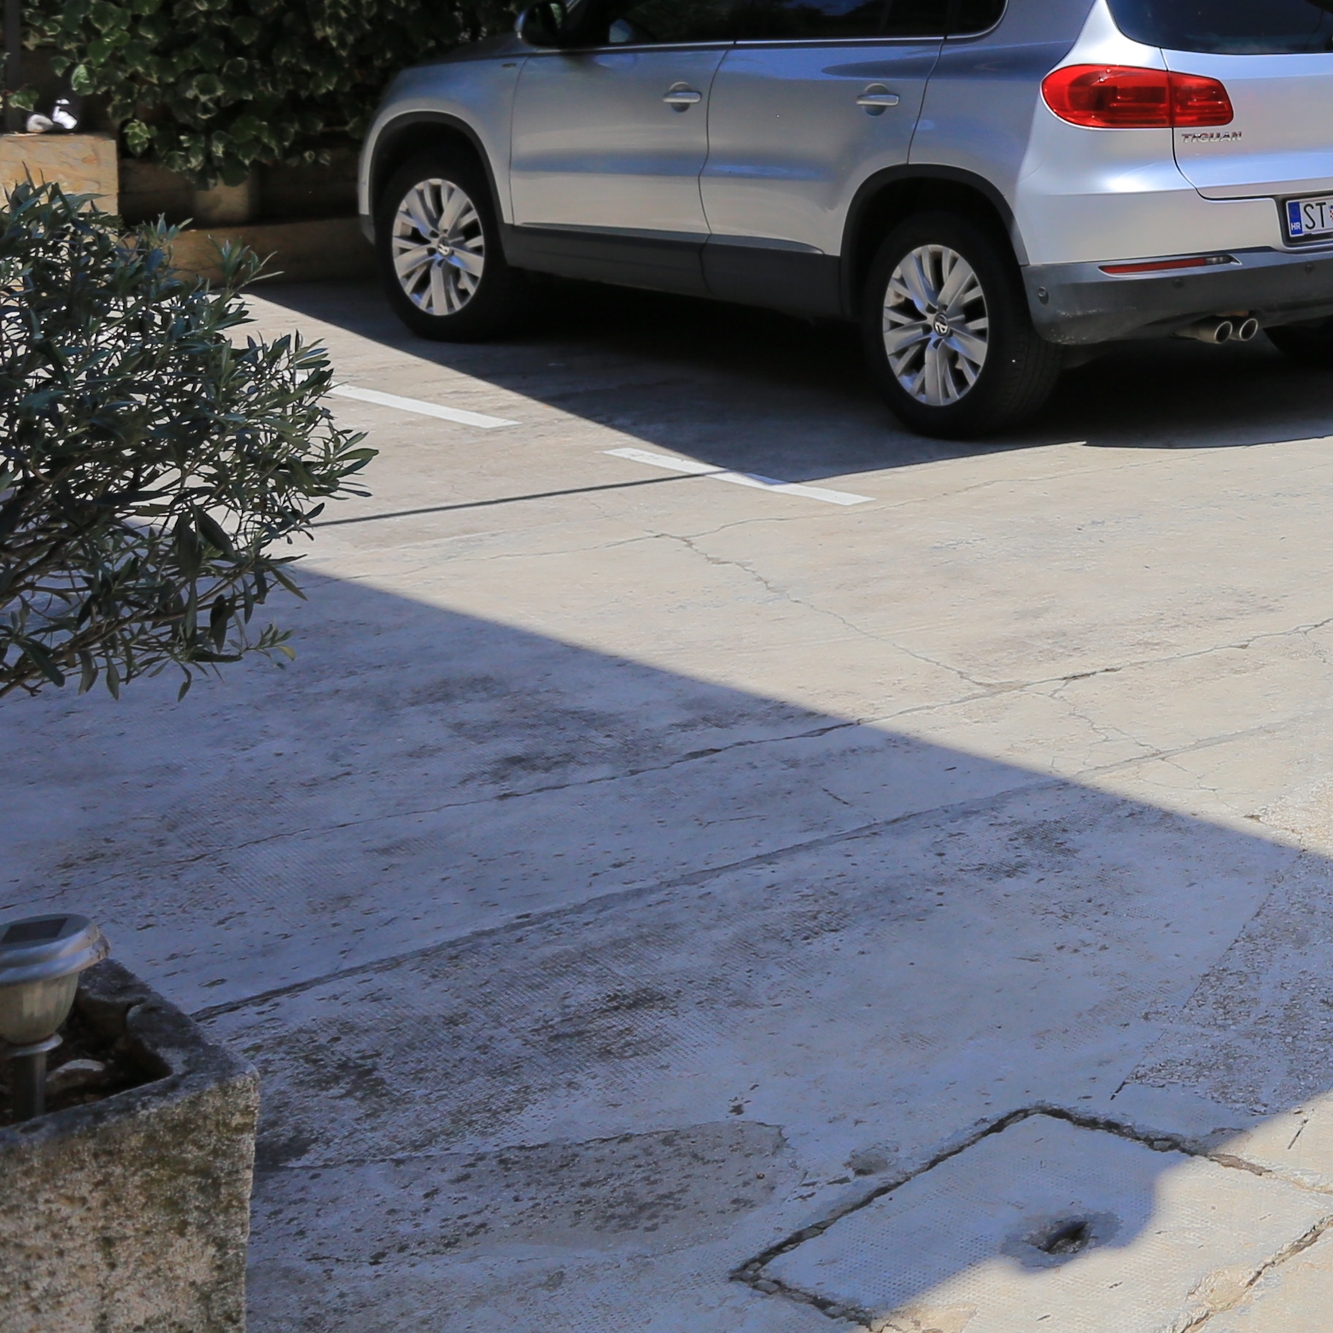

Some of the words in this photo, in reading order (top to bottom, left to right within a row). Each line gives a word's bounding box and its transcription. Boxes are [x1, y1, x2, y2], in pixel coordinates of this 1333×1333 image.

[1181, 131, 1242, 143] TIGUAN
[1303, 202, 1326, 230] ST
[1290, 222, 1301, 231] HR
